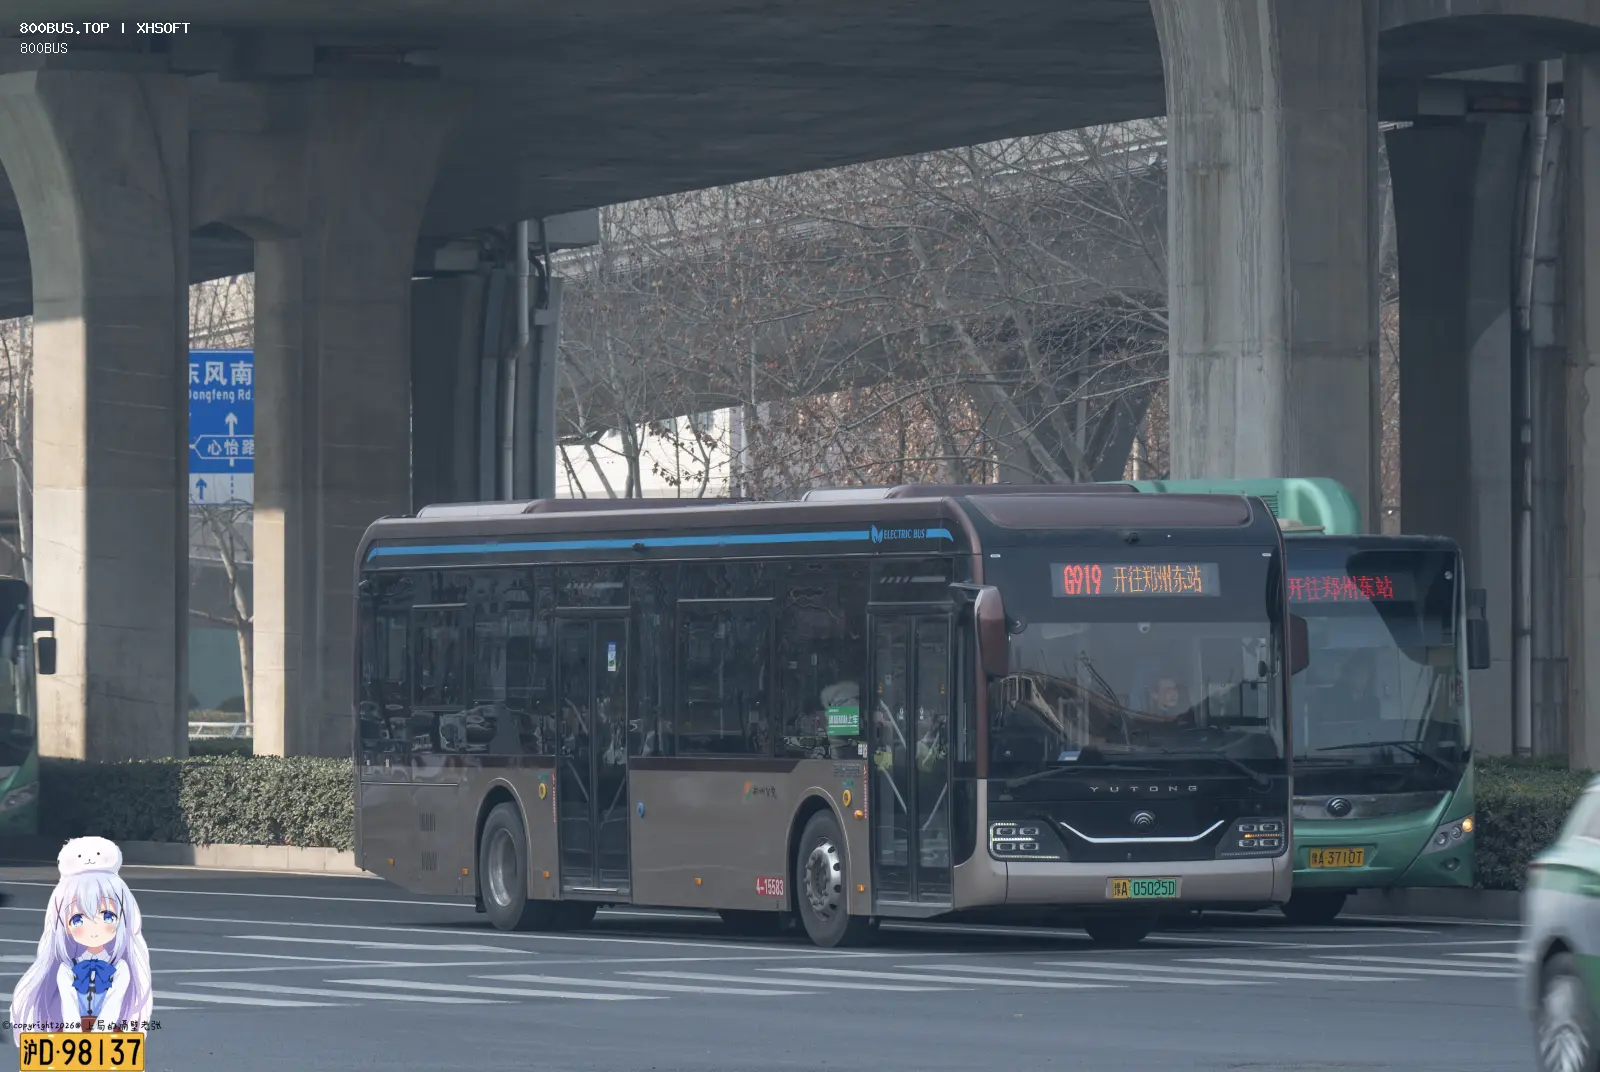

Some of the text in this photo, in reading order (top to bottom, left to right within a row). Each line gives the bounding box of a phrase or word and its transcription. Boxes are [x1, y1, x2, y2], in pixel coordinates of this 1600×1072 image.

[207, 438, 254, 456] 心怡路
[883, 528, 925, 539] ELECTRIC BUS
[1063, 564, 1202, 594] G919 开往郑州东站
[1287, 575, 1394, 600] 开往郑州东站
[1090, 785, 1198, 793] YUTONG
[756, 877, 784, 896] 4-15583
